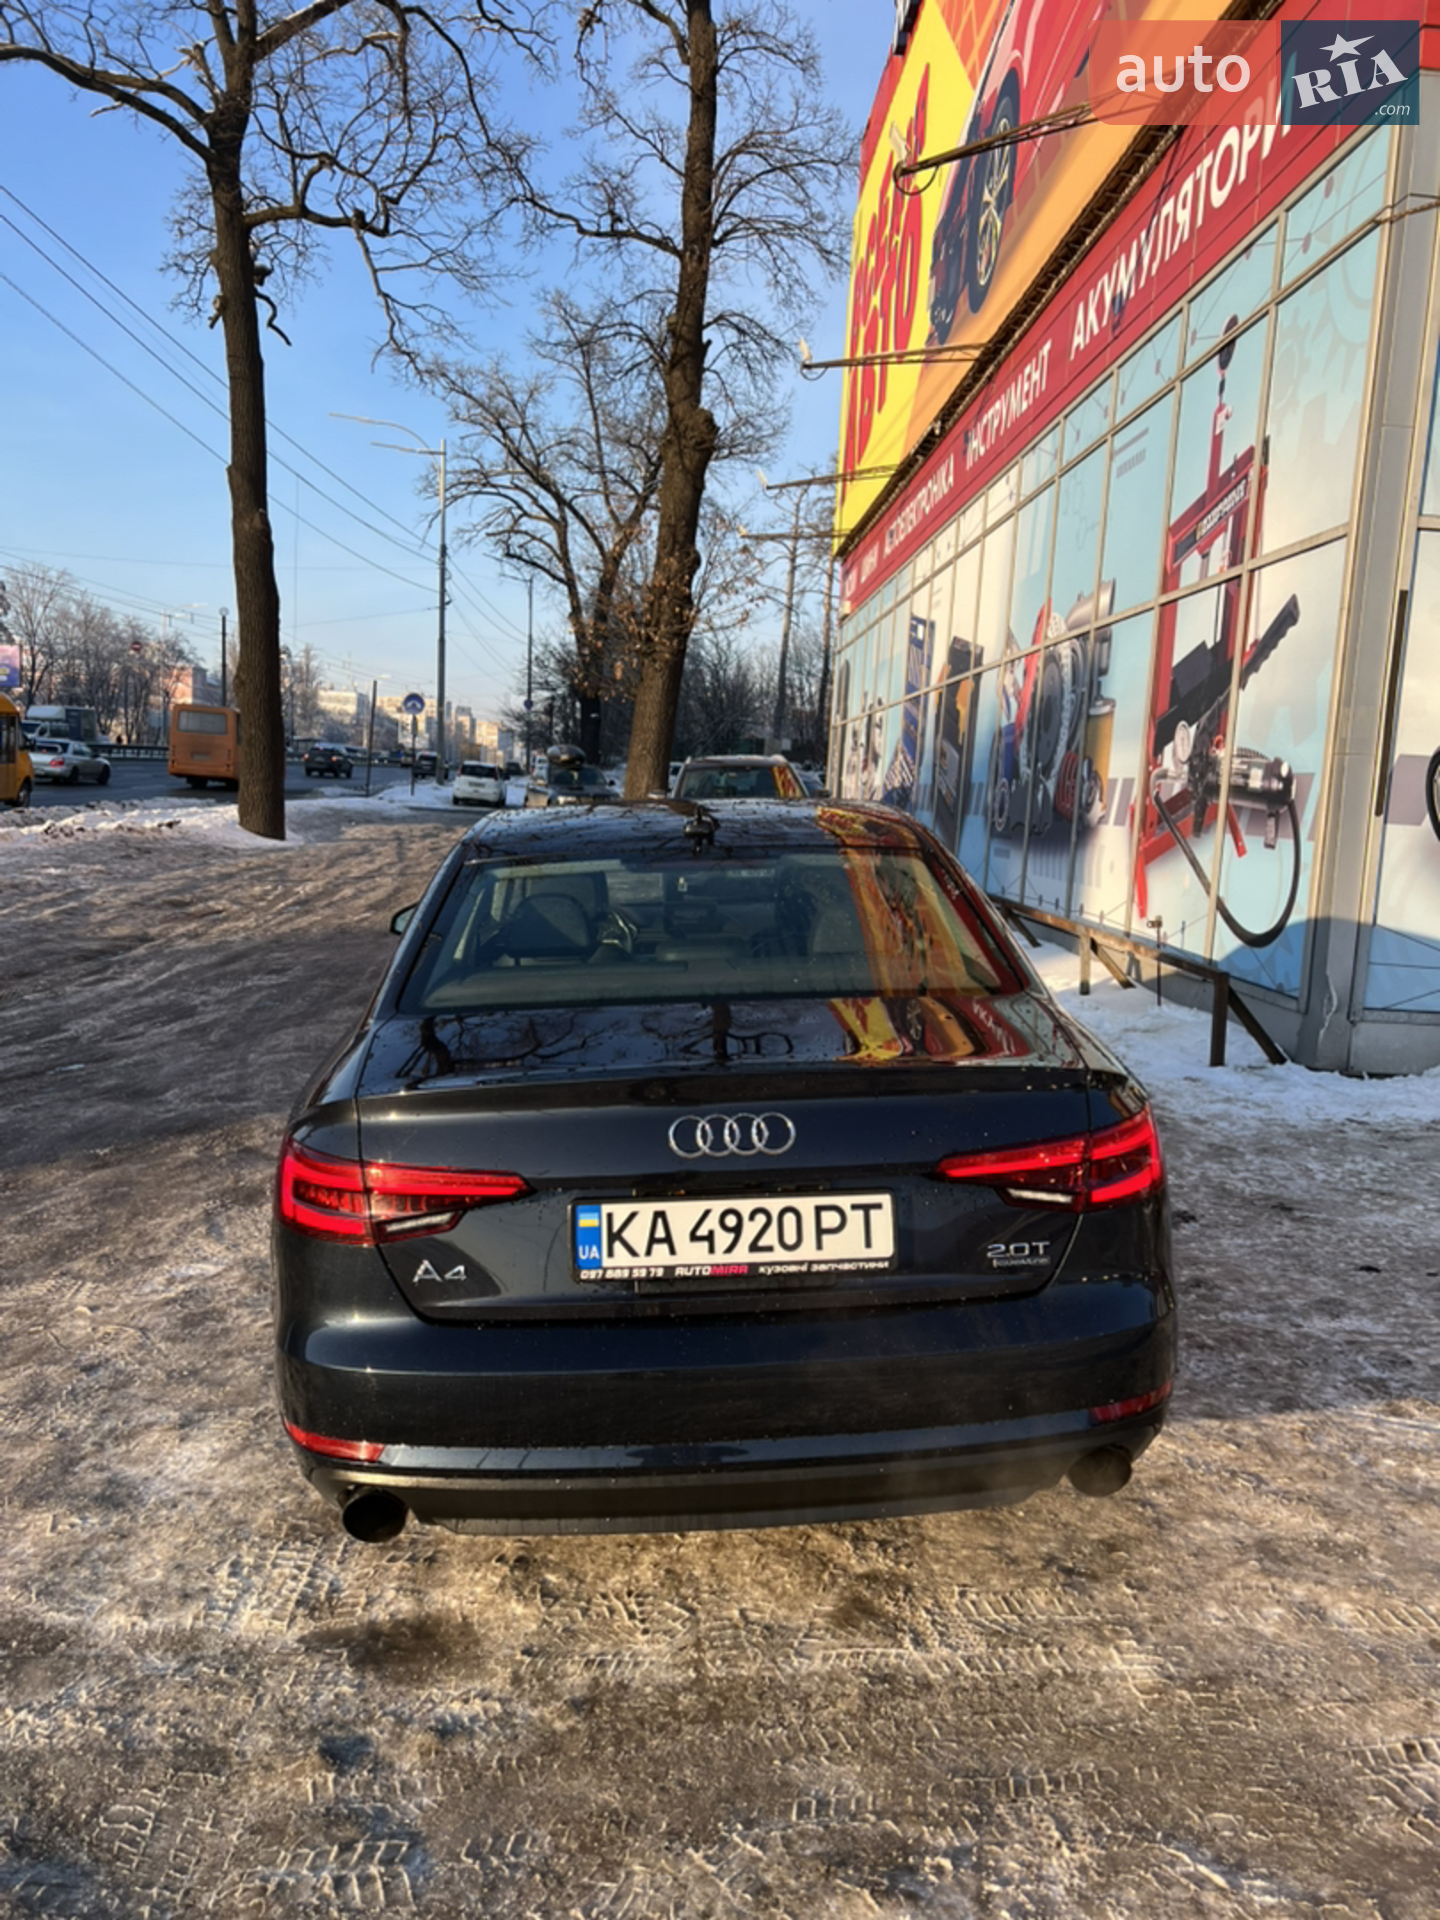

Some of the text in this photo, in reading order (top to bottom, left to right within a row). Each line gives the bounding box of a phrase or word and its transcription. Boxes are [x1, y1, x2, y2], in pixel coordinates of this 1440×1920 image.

[840, 184, 922, 508] АВТО
[966, 338, 1053, 471] ІНСТРУМЕНТ
[605, 1202, 884, 1259] KA 4920 PT
[412, 1259, 467, 1283] A4
[578, 1245, 600, 1260] UA
[580, 1269, 603, 1279] 097
